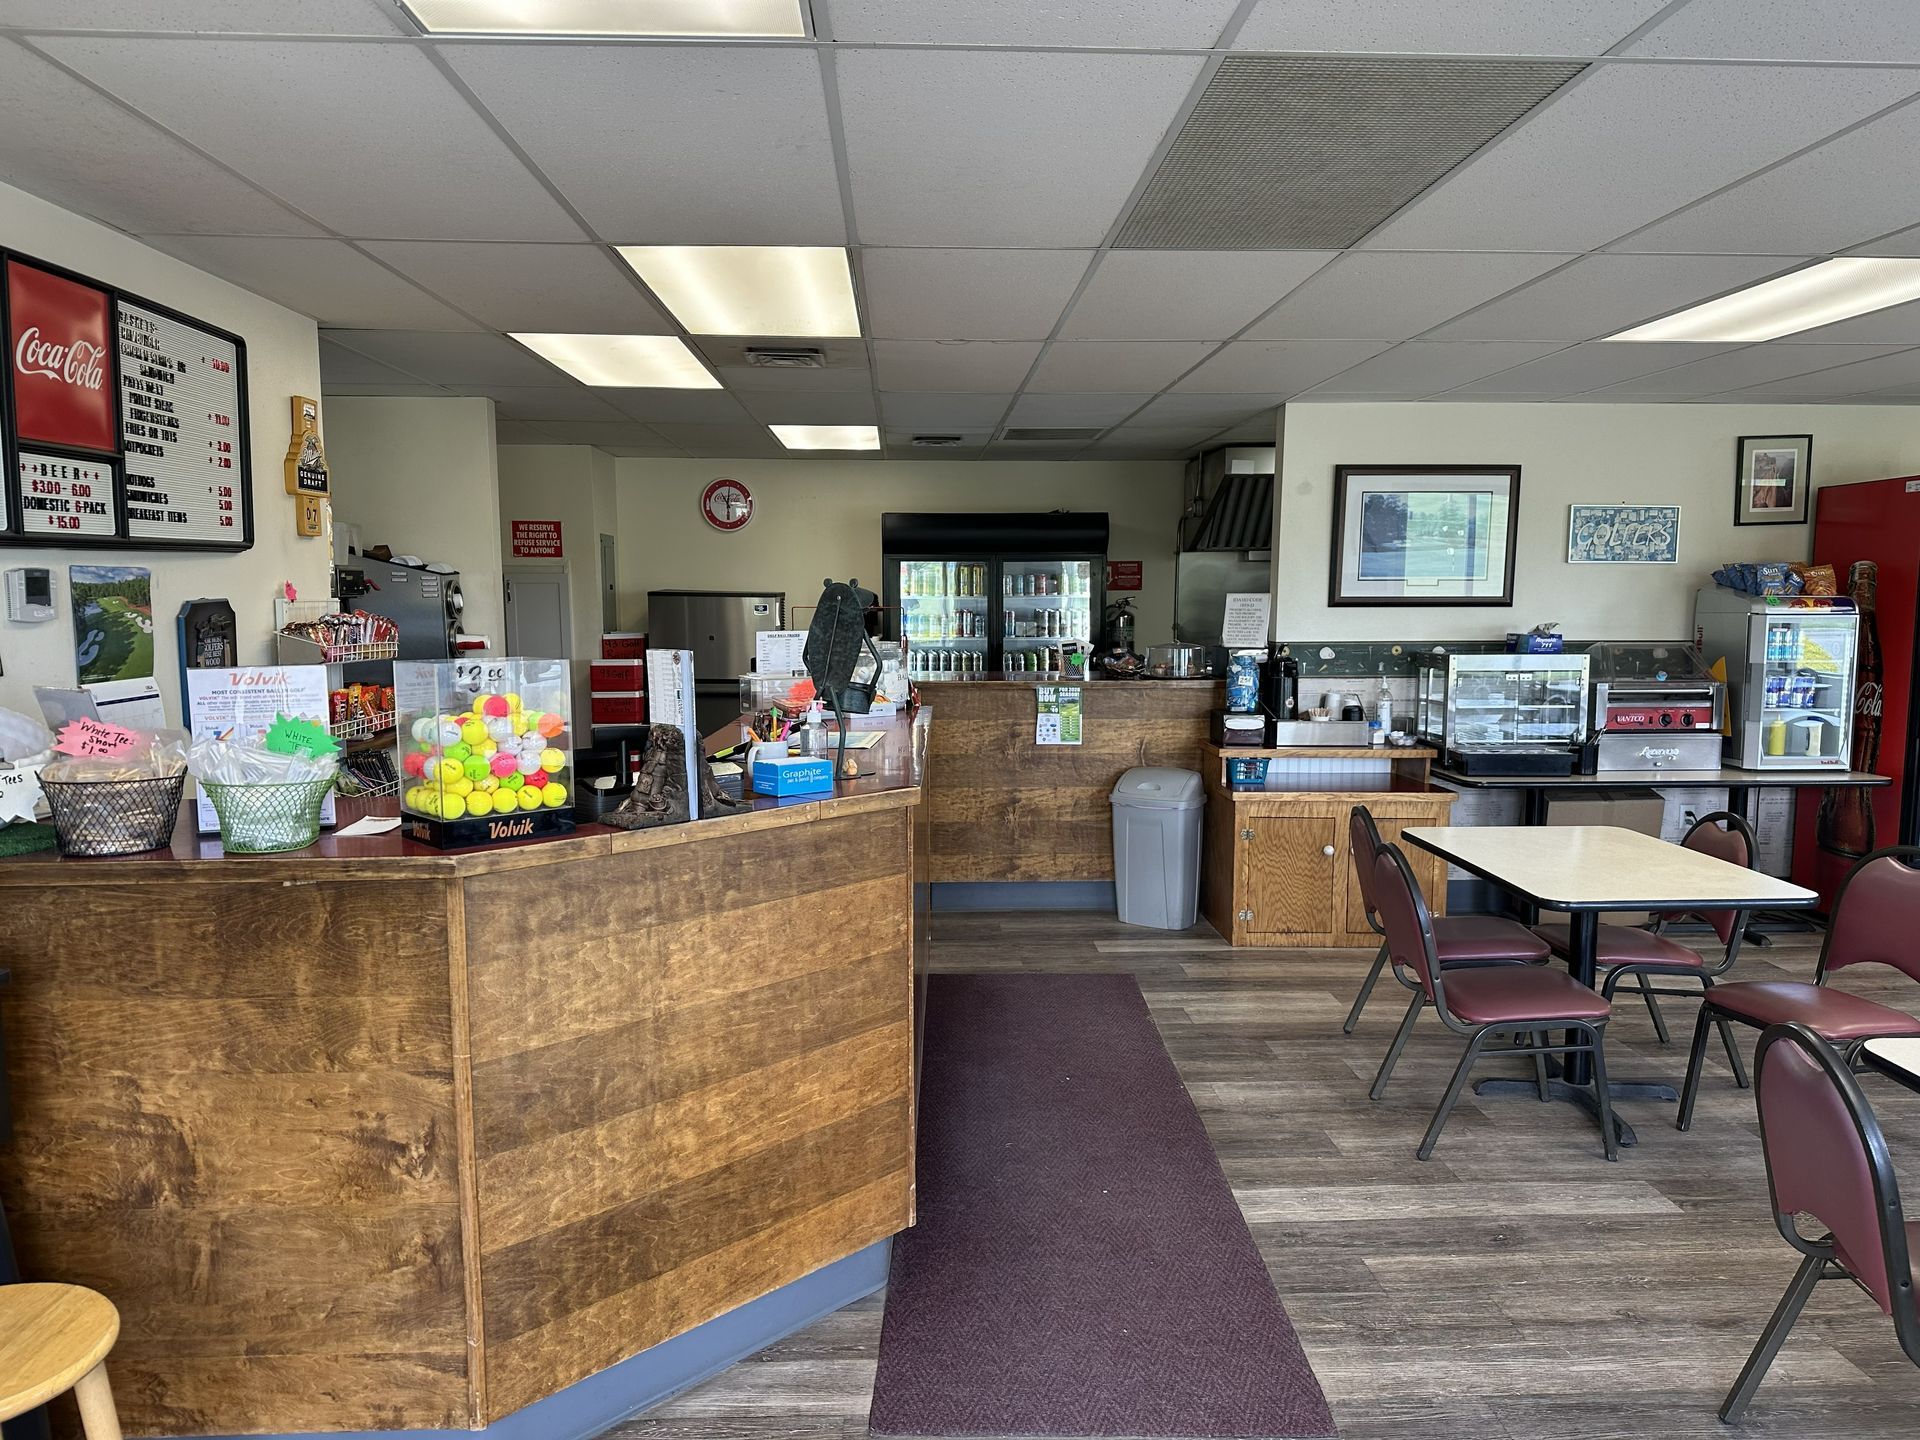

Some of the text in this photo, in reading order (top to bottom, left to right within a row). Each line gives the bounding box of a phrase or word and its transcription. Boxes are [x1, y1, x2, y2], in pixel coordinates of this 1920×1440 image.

[15, 326, 106, 390] Coca-Cola
[125, 421, 178, 443] FRIES OR TOTS
[40, 463, 80, 480] BEER
[300, 470, 326, 481] GENUINE
[303, 478, 322, 488] DRAFT
[218, 486, 232, 498] 5.00
[23, 496, 107, 515] DOMESTIC 6-PACK
[219, 500, 233, 511] 5.00
[167, 511, 188, 524] ITEMS
[220, 515, 233, 526] 5.00
[518, 523, 528, 531] WE
[516, 531, 528, 539] THE
[1576, 519, 1673, 552] GOLFERS
[536, 539, 561, 547] SERVICE
[520, 546, 529, 554] TO
[1762, 567, 1779, 577] Sun
[205, 657, 221, 666] WOOD
[229, 671, 292, 687] Volvik
[1038, 687, 1055, 695] BUY
[1038, 694, 1057, 703] NOW
[1855, 681, 1883, 717] Cola
[80, 721, 111, 739] White
[89, 735, 117, 748] Short
[285, 729, 313, 745] WHITE
[782, 767, 821, 779] Graphite
[2, 774, 23, 785] Tees
[488, 817, 535, 840] Volvik
